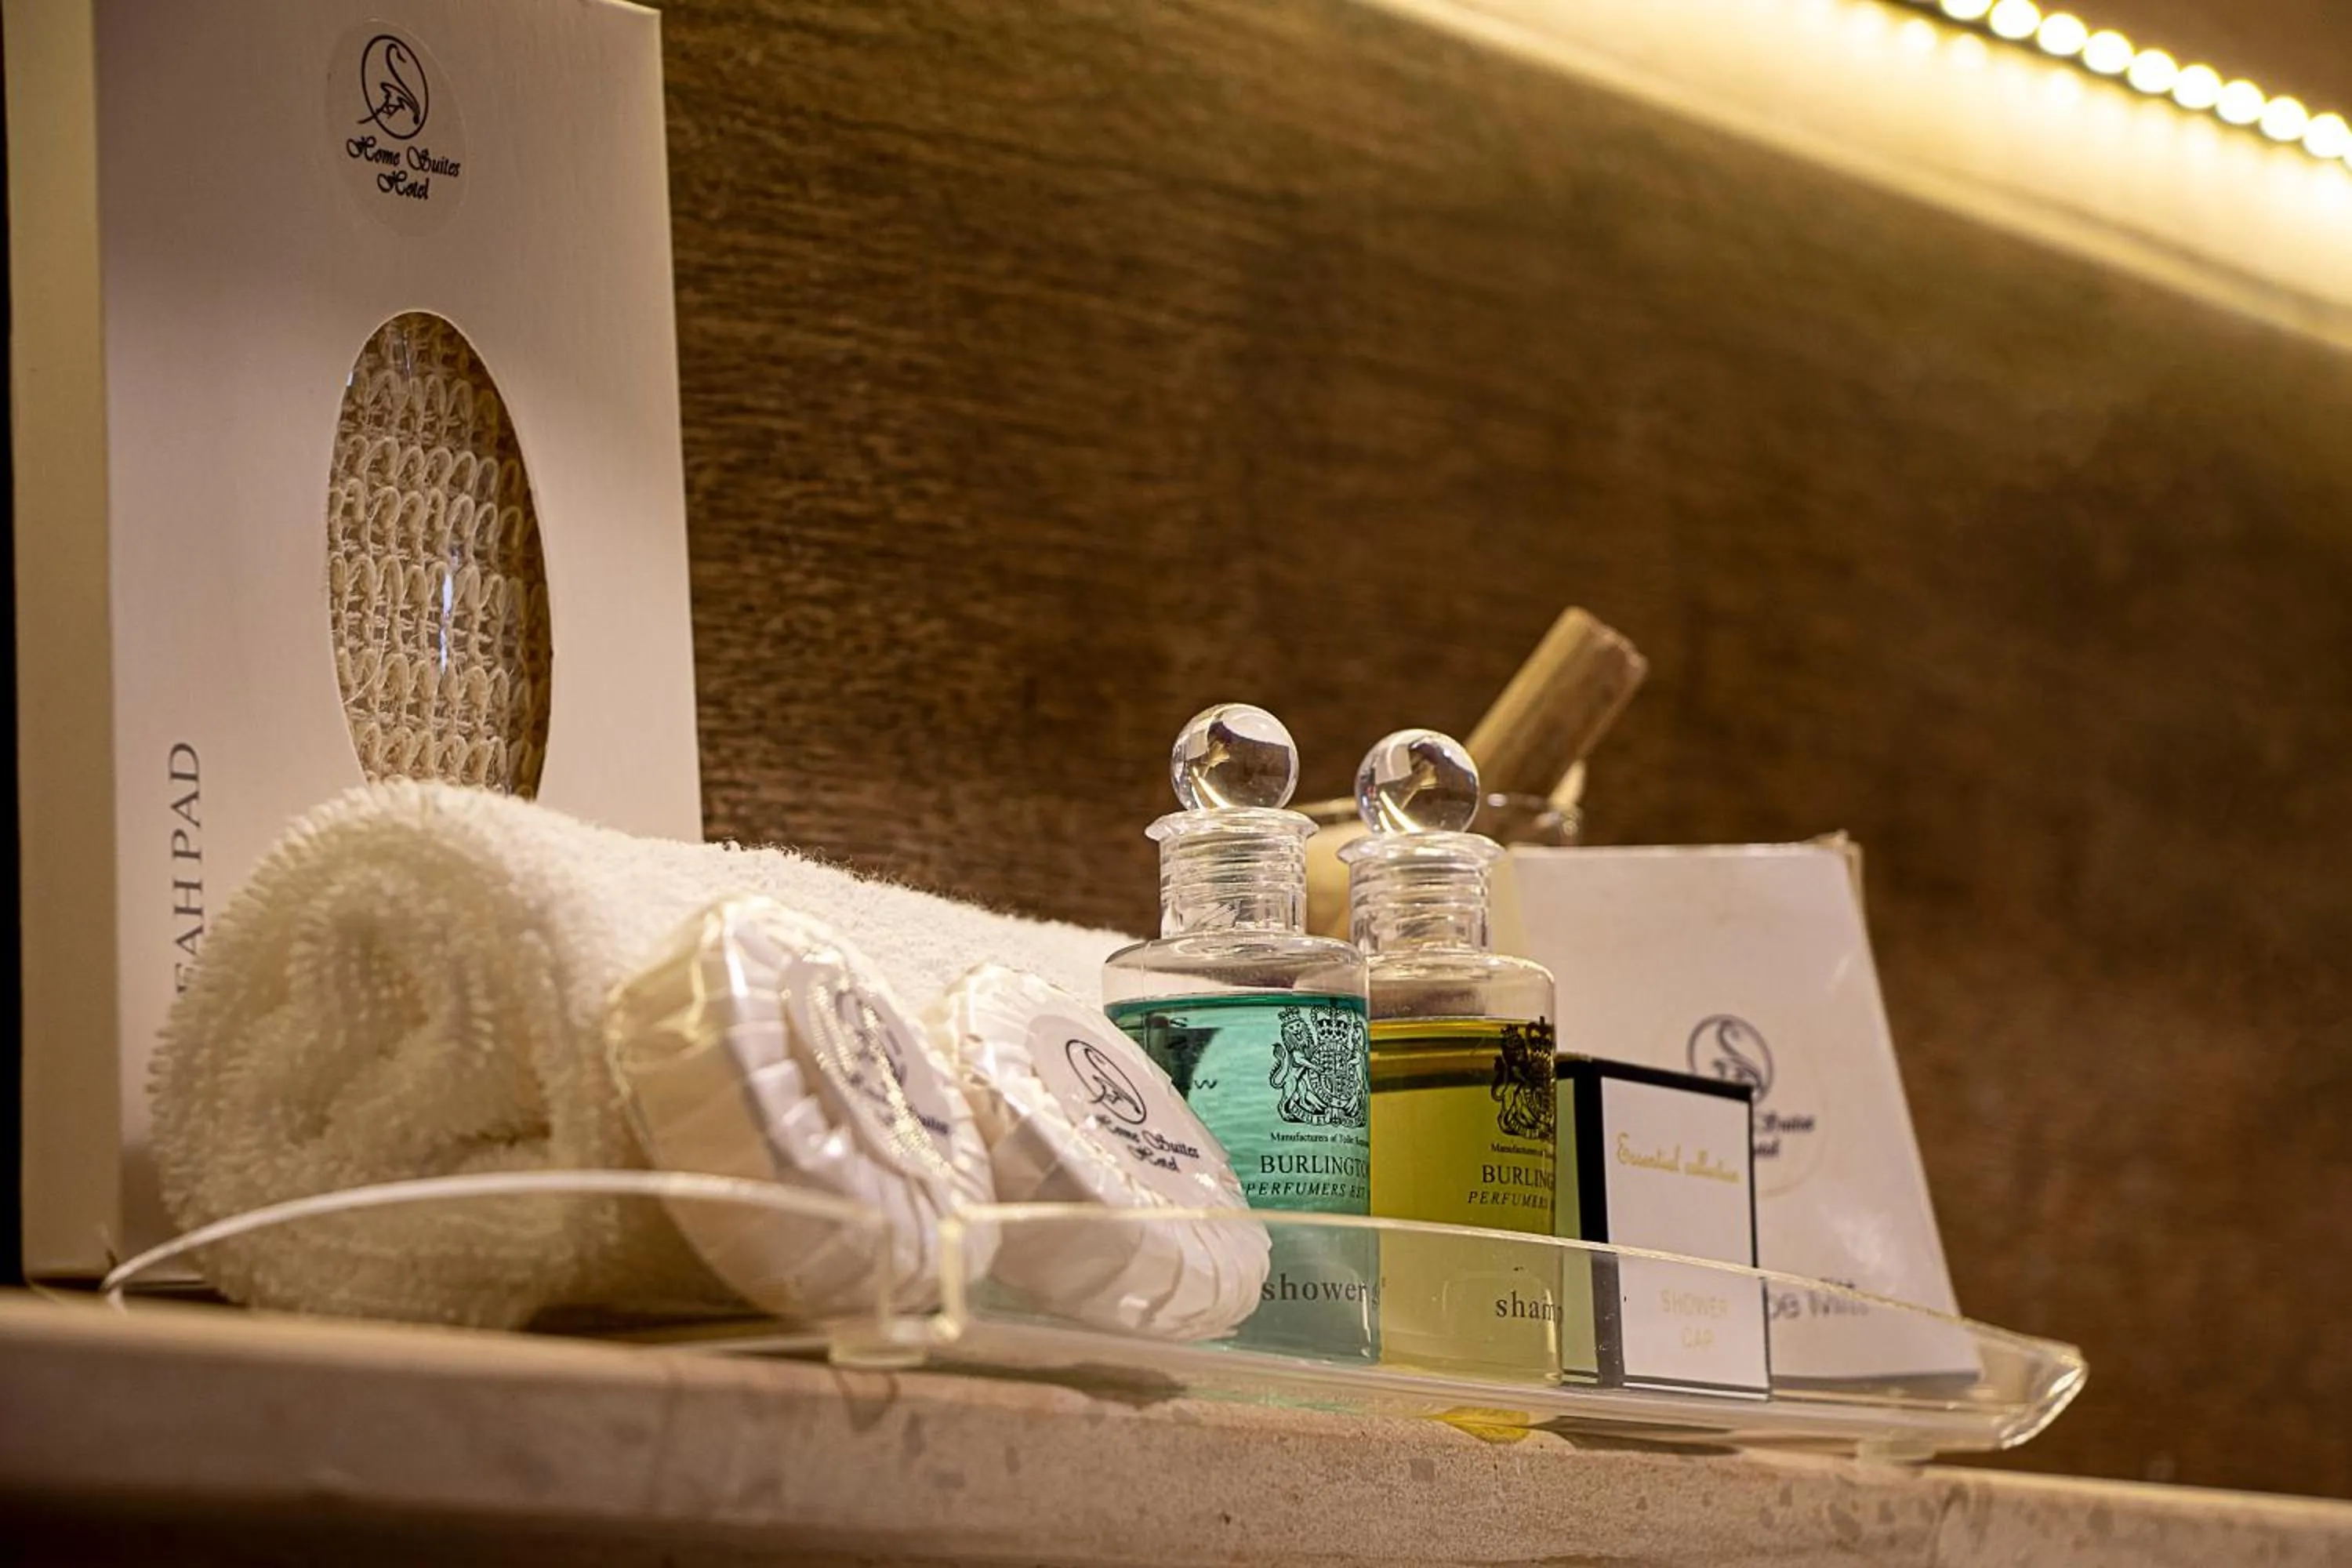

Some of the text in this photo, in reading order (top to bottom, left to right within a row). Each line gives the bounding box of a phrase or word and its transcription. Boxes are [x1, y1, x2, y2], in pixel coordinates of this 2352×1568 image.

[346, 136, 461, 177] Home Suites
[376, 170, 430, 200] Hotel
[1261, 1272, 1368, 1302] shower
[1659, 1288, 1728, 1319] SHOWER
